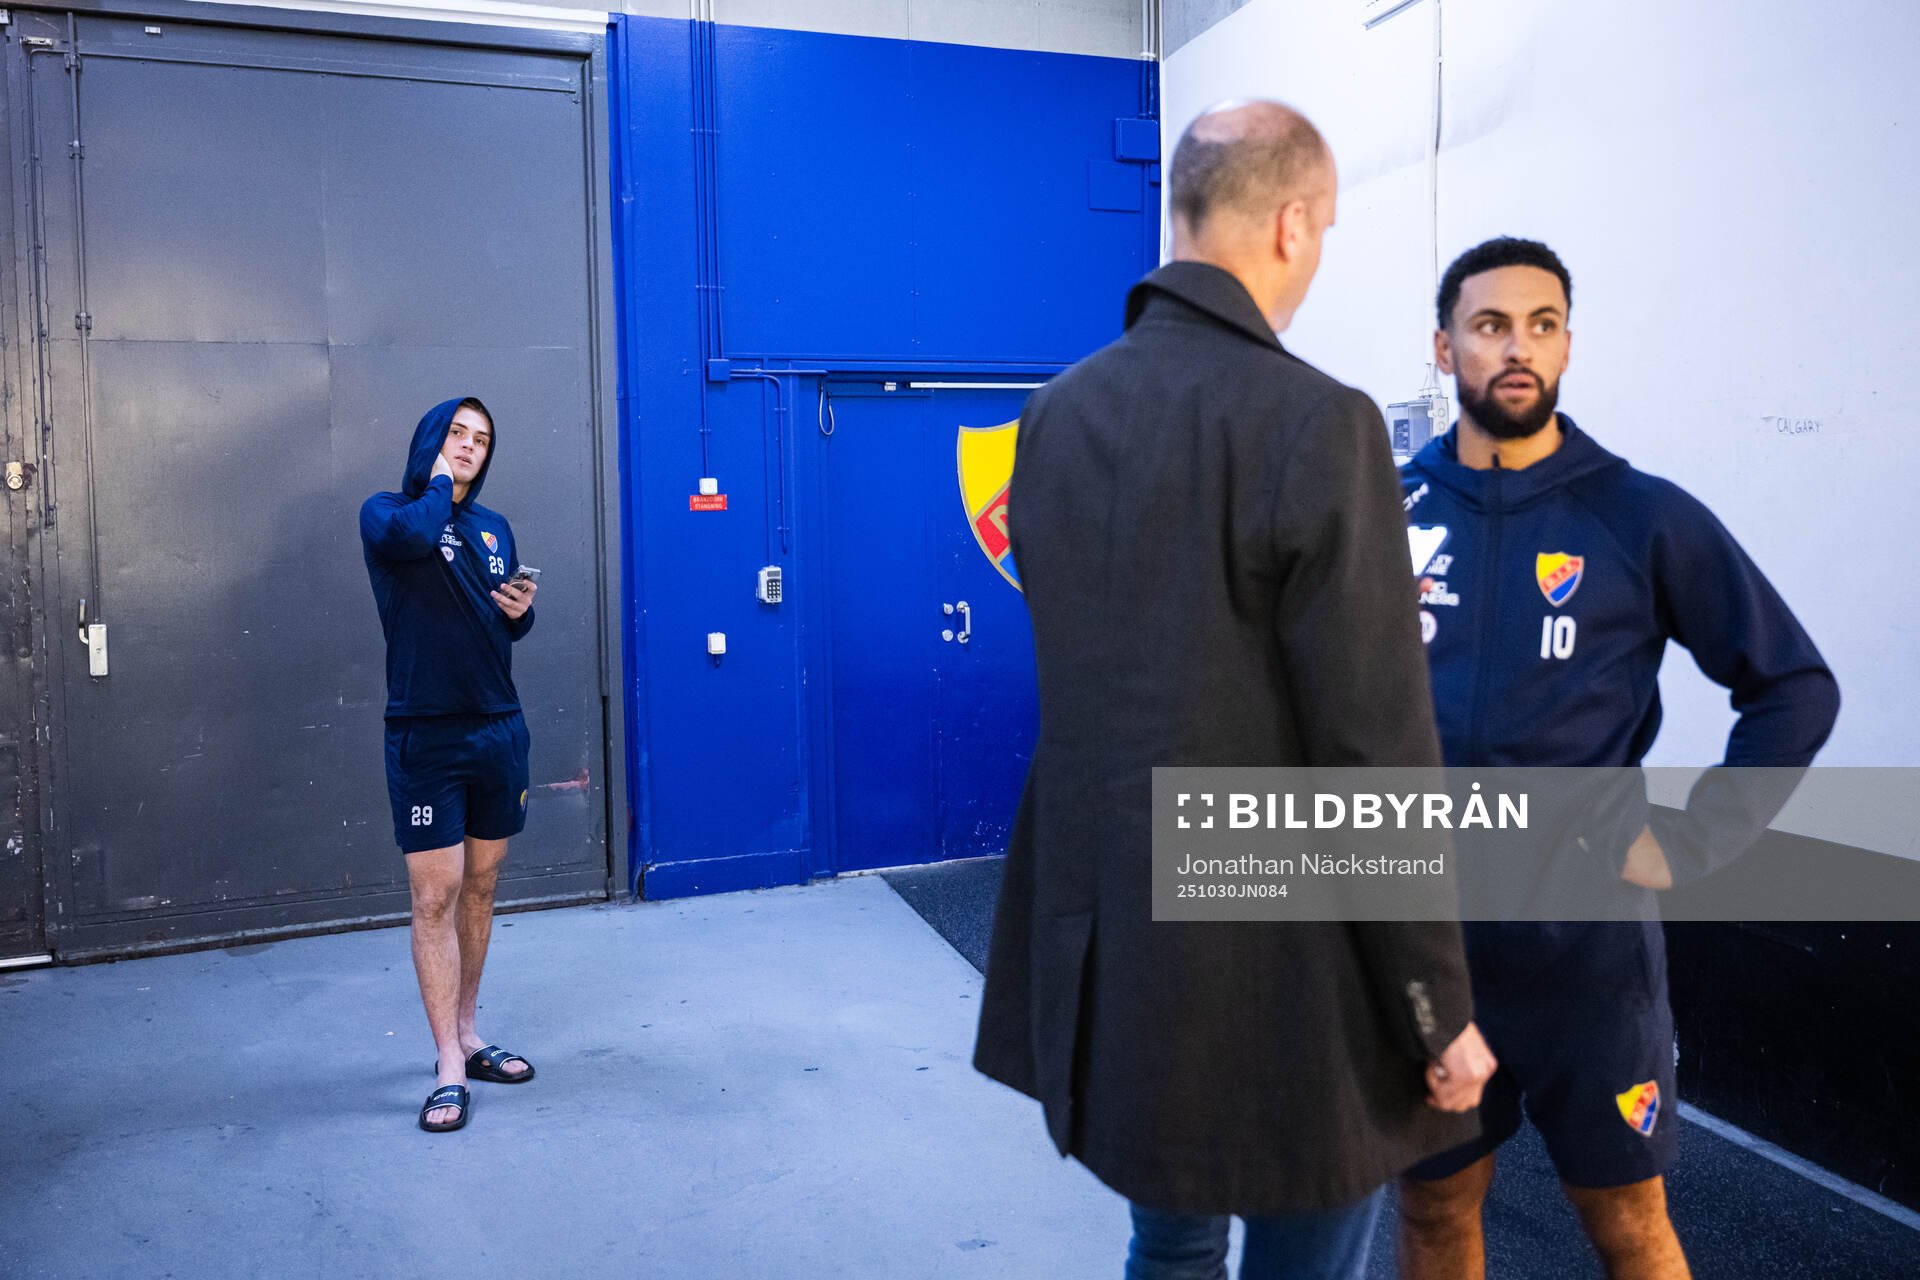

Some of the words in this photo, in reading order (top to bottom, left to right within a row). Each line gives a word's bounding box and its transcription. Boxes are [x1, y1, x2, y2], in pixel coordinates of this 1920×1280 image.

[1776, 417, 1821, 434] CALGARY
[488, 555, 504, 576] 29
[1540, 615, 1577, 660] 10
[411, 805, 433, 825] 29
